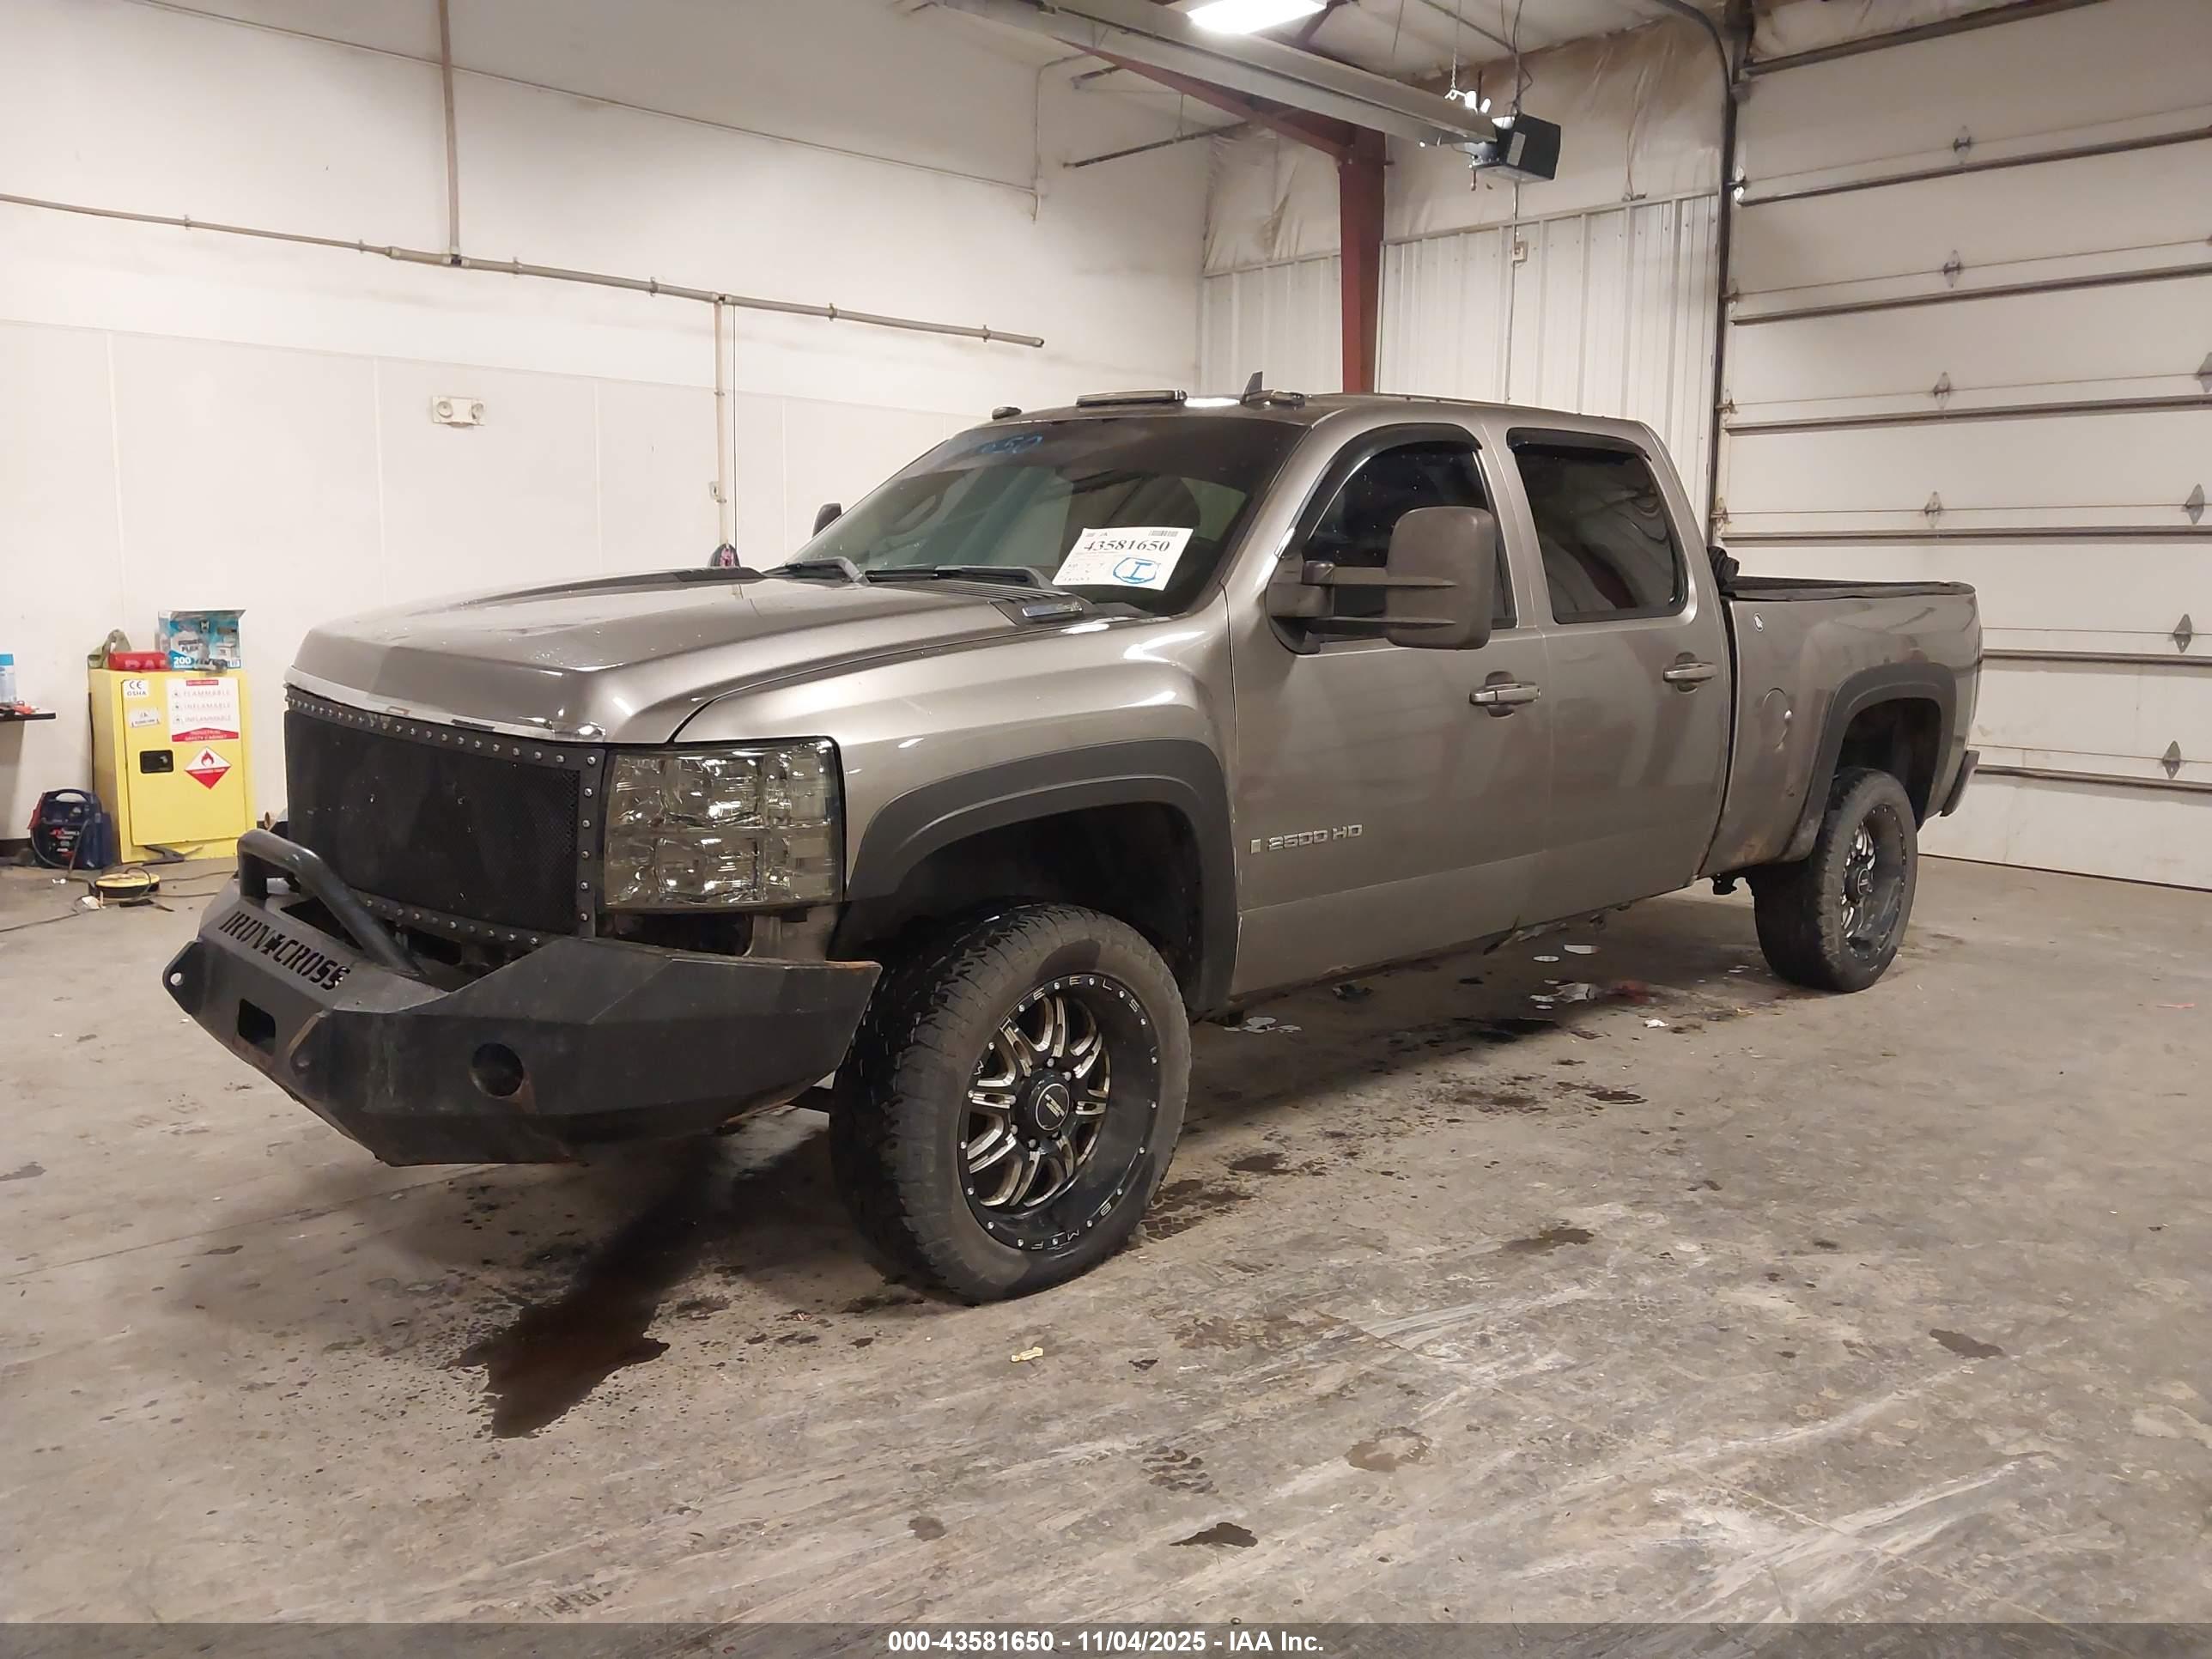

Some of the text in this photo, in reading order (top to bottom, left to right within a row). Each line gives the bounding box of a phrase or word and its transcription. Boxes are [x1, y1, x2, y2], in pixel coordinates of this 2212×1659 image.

[1084, 539, 1170, 553] 43581650
[173, 656, 191, 665] 200
[1267, 823, 1364, 851] 2500 HD
[218, 910, 351, 991] IRON CROSS
